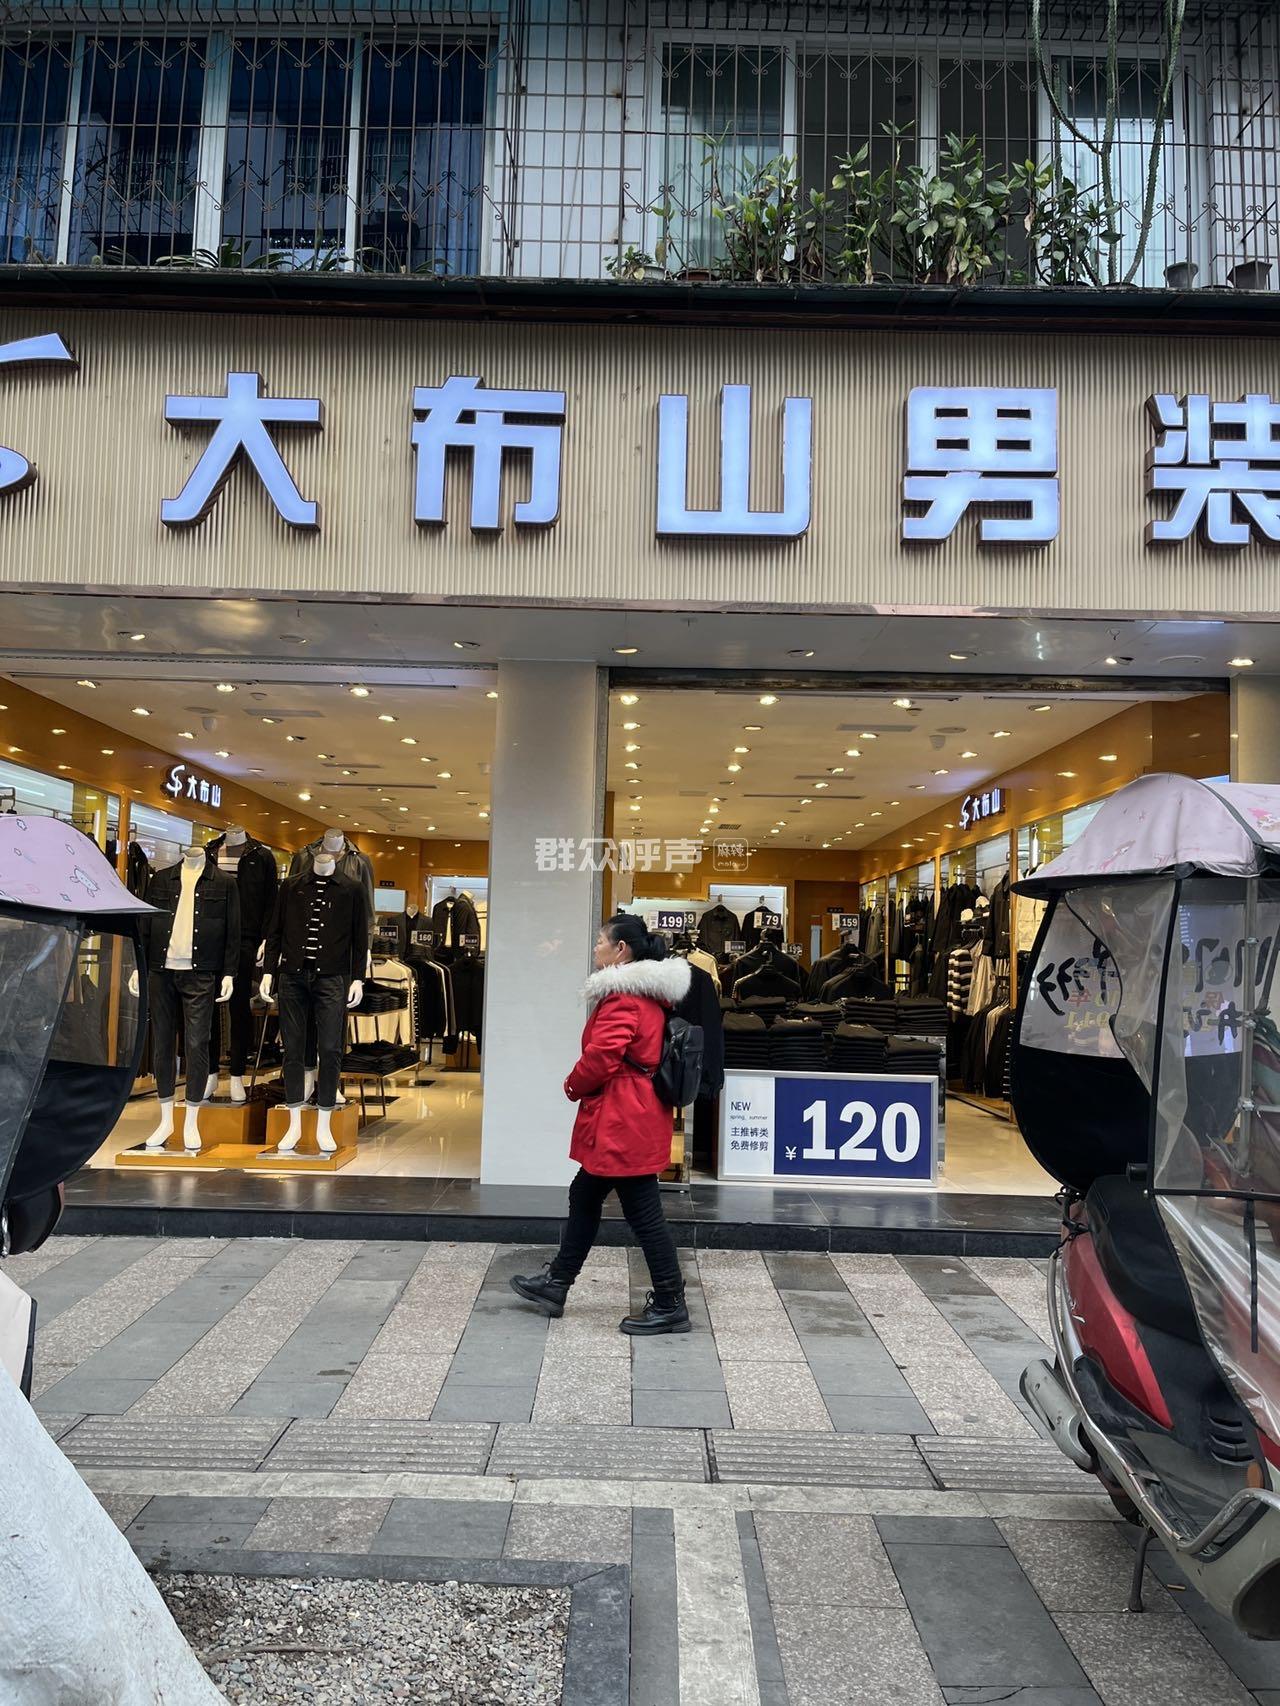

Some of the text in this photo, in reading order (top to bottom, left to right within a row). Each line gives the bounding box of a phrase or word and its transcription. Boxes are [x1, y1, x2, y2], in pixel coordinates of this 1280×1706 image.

[161, 371, 1280, 548] 大布山男装
[186, 775, 221, 808] 大布山
[972, 788, 1000, 821] 大布山
[730, 1101, 752, 1111] NEW
[730, 1126, 769, 1138] 主推裤类
[730, 1140, 769, 1152] 免费修剪
